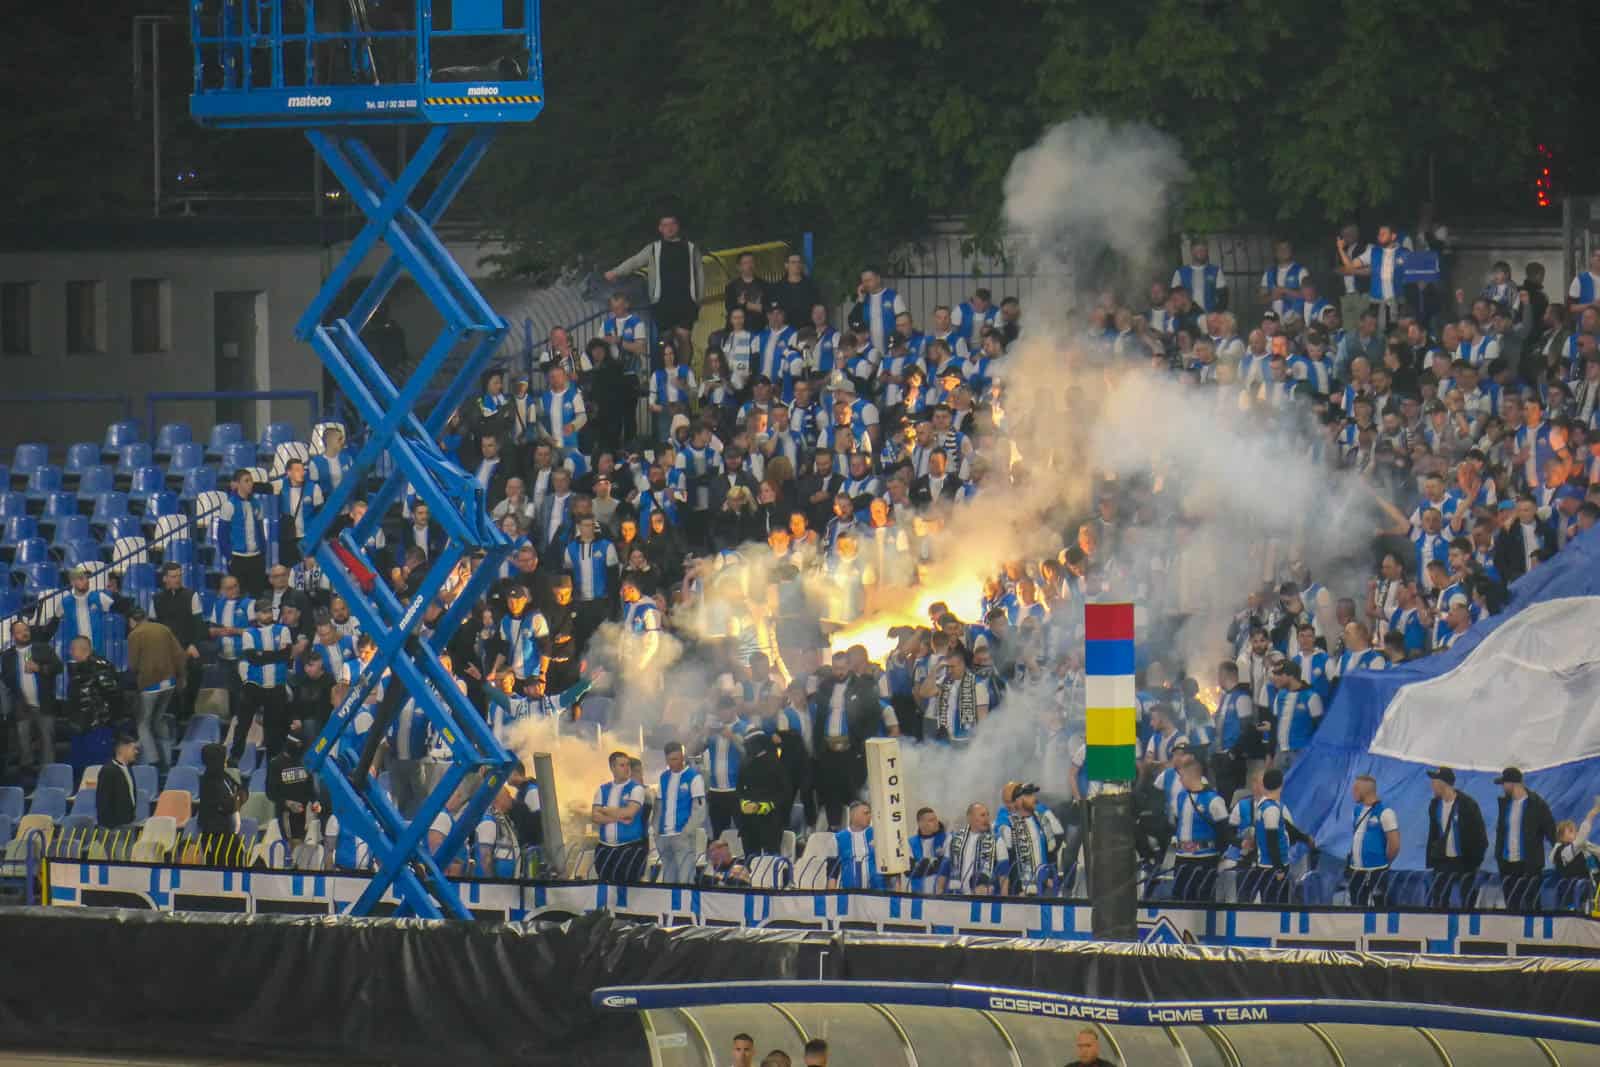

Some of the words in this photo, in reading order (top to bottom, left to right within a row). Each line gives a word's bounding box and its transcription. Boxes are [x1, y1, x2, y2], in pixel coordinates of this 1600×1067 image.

[468, 86, 499, 96] mateco
[288, 95, 332, 107] mateco
[887, 757, 905, 858] TONSIL
[989, 996, 1120, 1021] GOSPODARZE
[1149, 1009, 1204, 1022] HOME
[1213, 1007, 1268, 1021] TEAM
